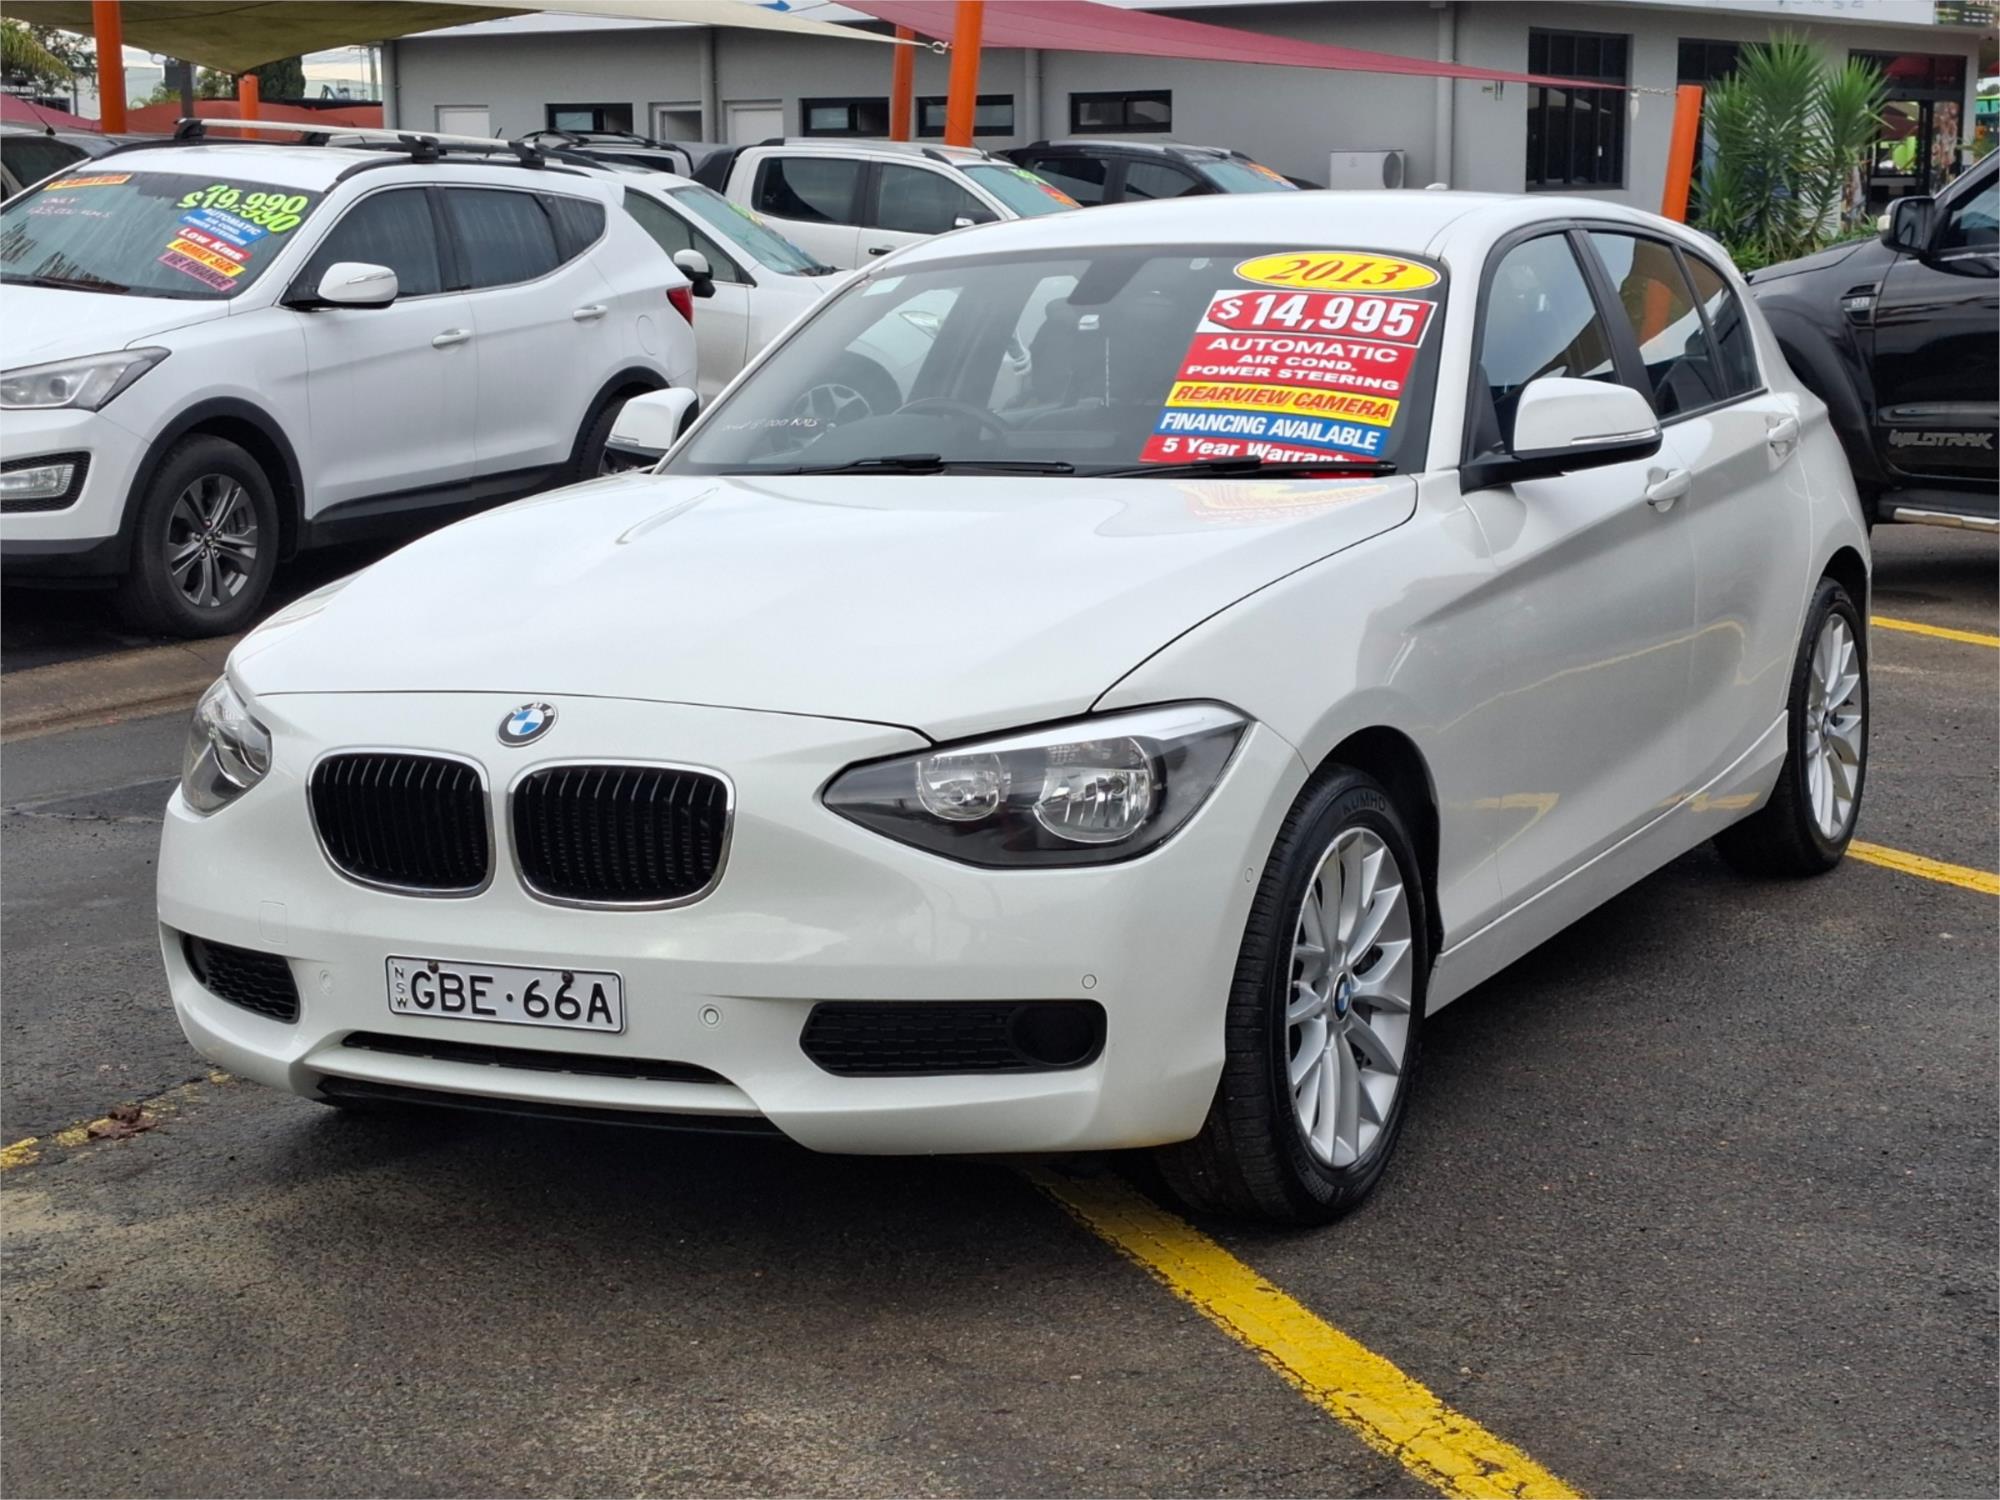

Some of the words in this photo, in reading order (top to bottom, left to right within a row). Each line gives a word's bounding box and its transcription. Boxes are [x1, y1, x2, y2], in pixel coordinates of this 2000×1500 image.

[202, 208, 262, 236] AUTOMATIC
[179, 228, 210, 244] Low
[174, 241, 211, 260] FAMILY
[209, 256, 238, 273] SIZE
[180, 261, 231, 288] FINANCE
[1264, 258, 1409, 285] 2013
[1206, 337, 1400, 363] AUTOMATIC
[1237, 354, 1279, 366] AIR
[1285, 356, 1358, 372] COND.
[1186, 364, 1272, 379] POWER
[1276, 368, 1400, 391] STEERING
[1173, 384, 1295, 406] REARVIEW
[1292, 391, 1392, 420] CAMERA
[1159, 411, 1268, 437] FINANCING
[1270, 418, 1382, 451] AVAILABLE
[1888, 428, 1994, 450] WILDTRAK
[1161, 437, 1180, 453] 5
[1186, 438, 1241, 458] Year
[1245, 442, 1351, 463] Warrant
[1342, 791, 1386, 814] KUMHO
